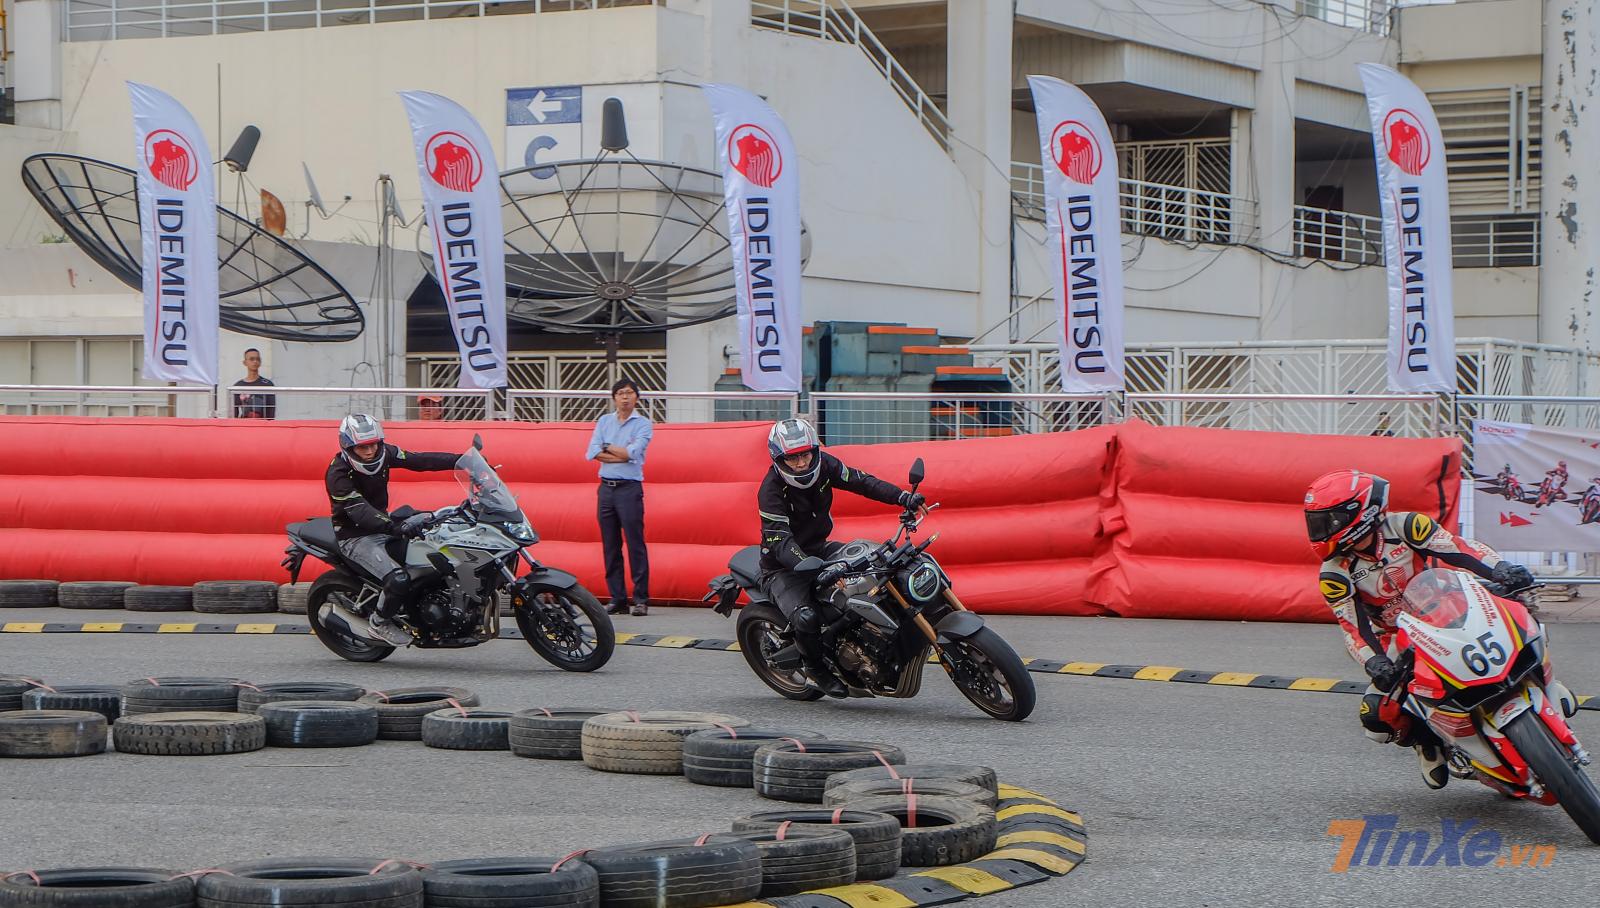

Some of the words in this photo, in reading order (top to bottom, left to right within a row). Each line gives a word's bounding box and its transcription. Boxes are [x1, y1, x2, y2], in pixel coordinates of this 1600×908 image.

[524, 135, 558, 180] C
[155, 199, 189, 367] IDEMITSU
[441, 201, 498, 371] IDEMITSU
[745, 197, 782, 373] IDEMITSU
[1067, 194, 1106, 374] IDEMITSU
[1399, 185, 1429, 373] IDEMITSU
[1408, 623, 1428, 640] Honda
[1427, 633, 1452, 656] Racing
[1461, 631, 1506, 677] 65
